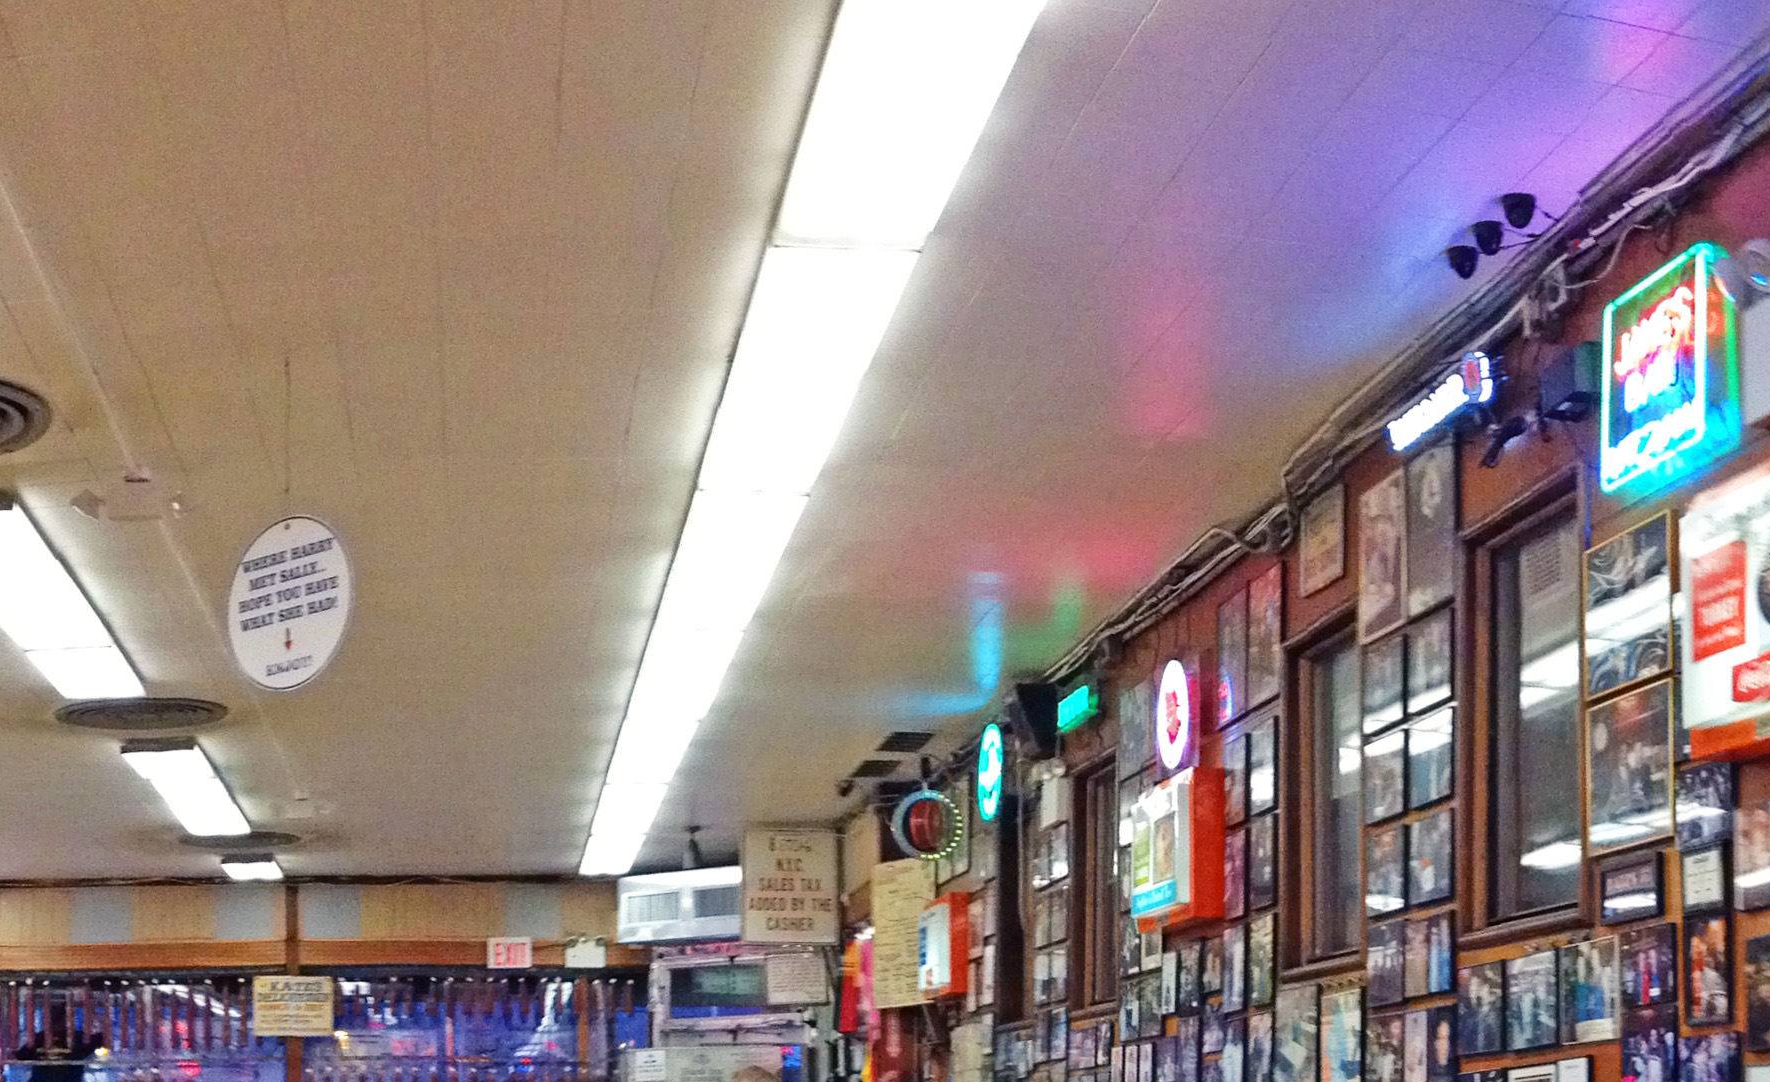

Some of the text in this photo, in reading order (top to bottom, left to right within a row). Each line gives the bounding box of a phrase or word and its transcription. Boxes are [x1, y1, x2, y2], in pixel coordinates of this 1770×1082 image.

[242, 550, 288, 574] WHERE
[248, 572, 276, 592] MET
[238, 594, 273, 614] HOPE
[275, 585, 303, 604] YOU
[240, 612, 276, 632] WHAT
[278, 604, 304, 623] SHE
[759, 877, 822, 892] SALES TAX
[748, 897, 832, 912] ADDED BY THE
[766, 917, 815, 931] CASHIER
[494, 941, 529, 967] EXIT
